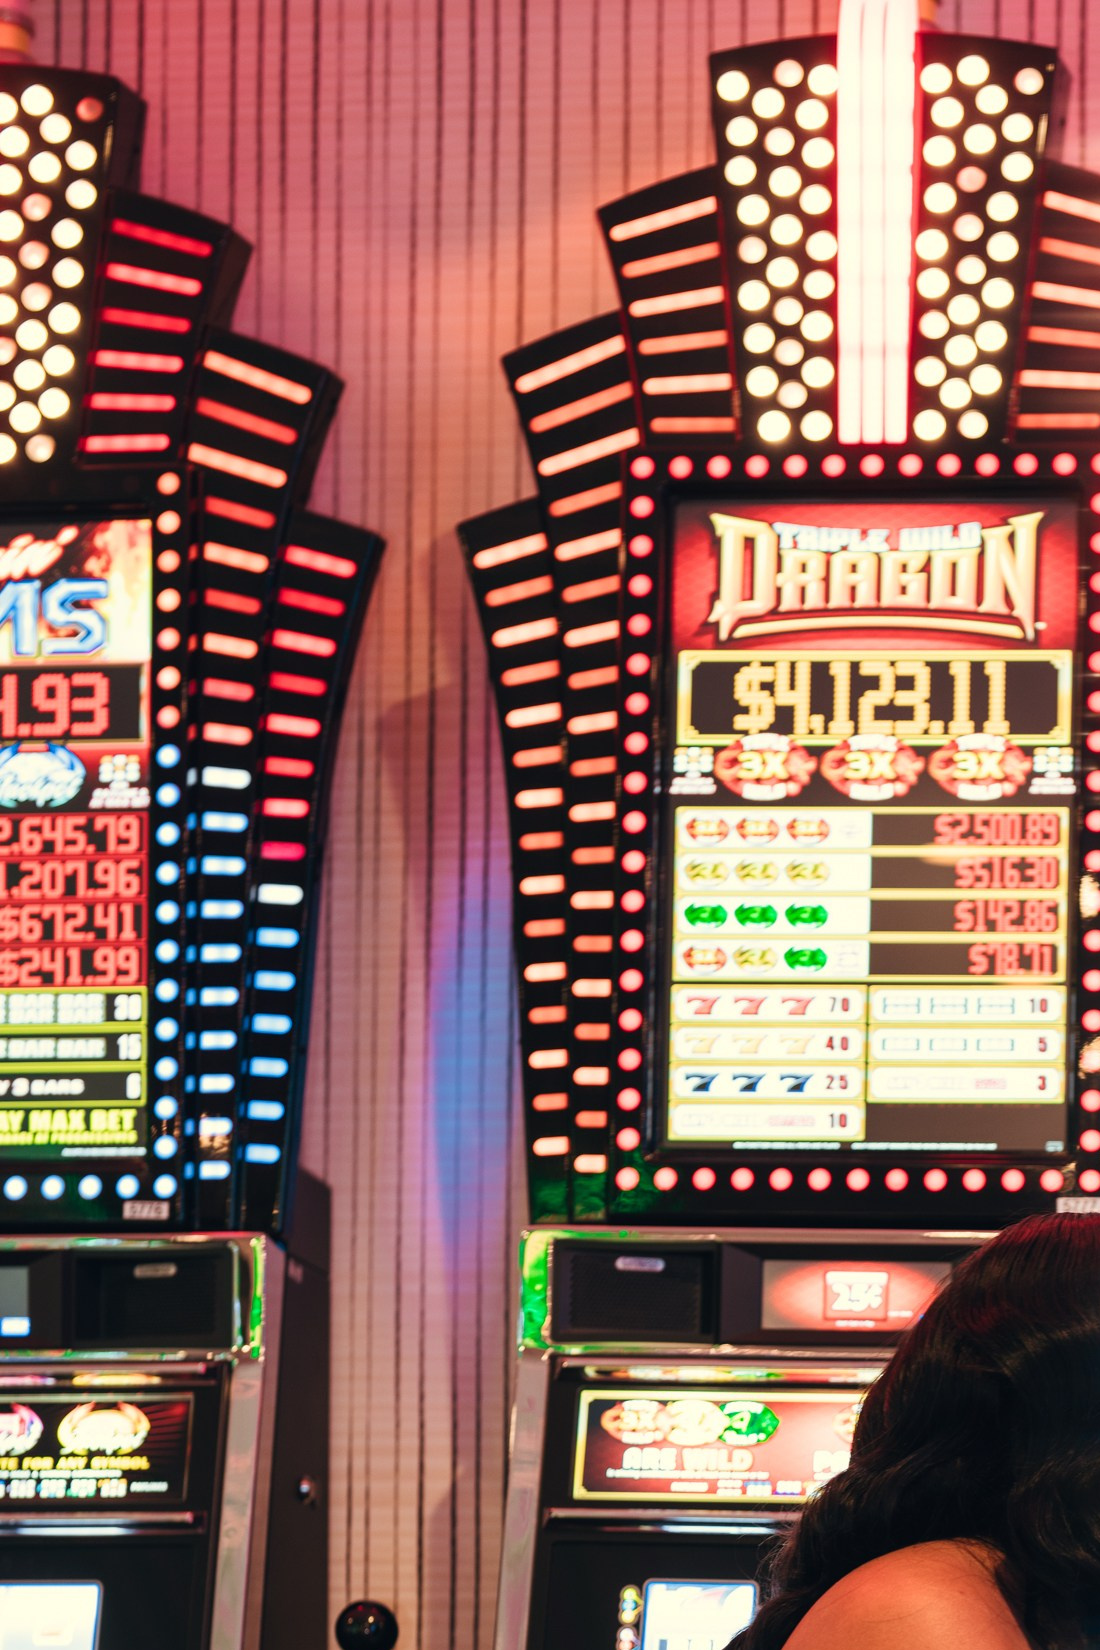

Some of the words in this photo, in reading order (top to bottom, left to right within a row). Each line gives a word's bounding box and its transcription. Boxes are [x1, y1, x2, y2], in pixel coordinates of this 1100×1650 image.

[772, 522, 890, 552] TRIPLE
[899, 521, 982, 552] WILD
[707, 512, 1046, 642] DRAGON
[733, 660, 1011, 735] $4,123.11
[738, 752, 788, 780] 3X
[845, 752, 895, 780] 3X
[953, 752, 1003, 780] 3X
[29, 1110, 85, 1131] MAX
[91, 1109, 136, 1131] BET
[22, 1456, 54, 1470] FOR
[56, 1456, 88, 1470] ANY
[682, 1447, 753, 1472] WILD
